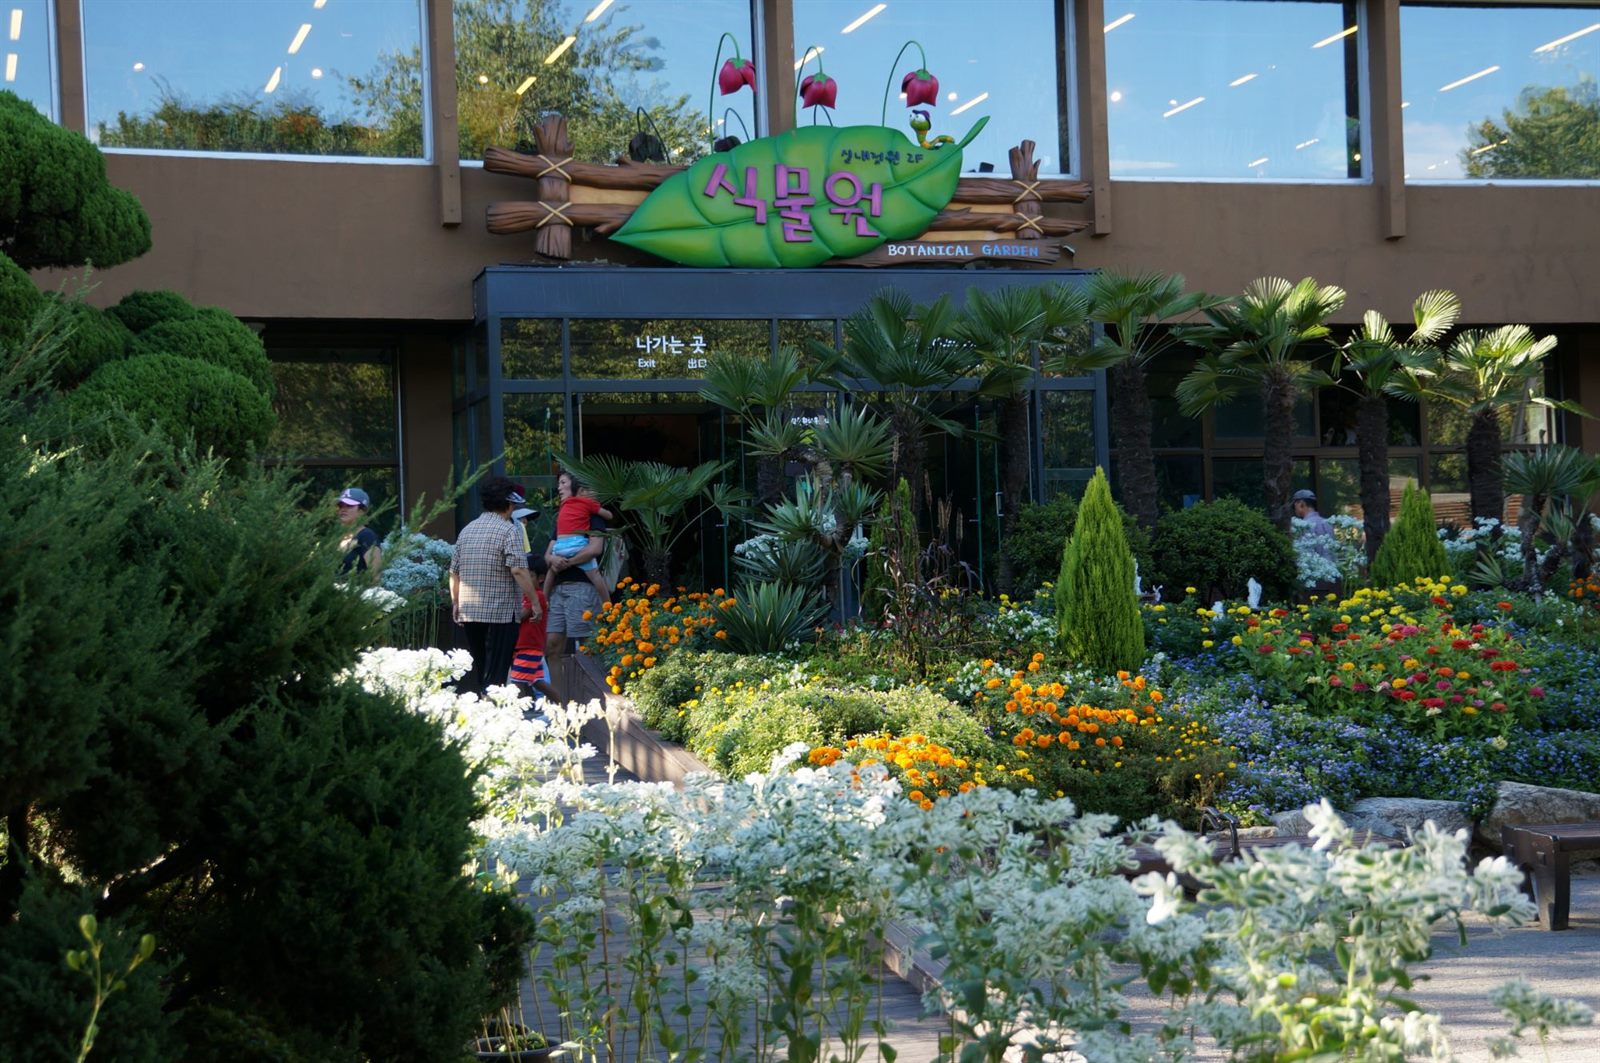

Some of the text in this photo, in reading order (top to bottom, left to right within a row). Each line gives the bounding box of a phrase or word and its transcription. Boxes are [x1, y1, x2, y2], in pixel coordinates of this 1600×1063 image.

[906, 153, 924, 164] 2F
[703, 162, 883, 243] 식물원
[887, 244, 1039, 257] BOTANICAL GARDEN
[636, 334, 707, 354] 나가는 곳
[638, 358, 656, 368] Exit
[687, 357, 707, 369] 出口
